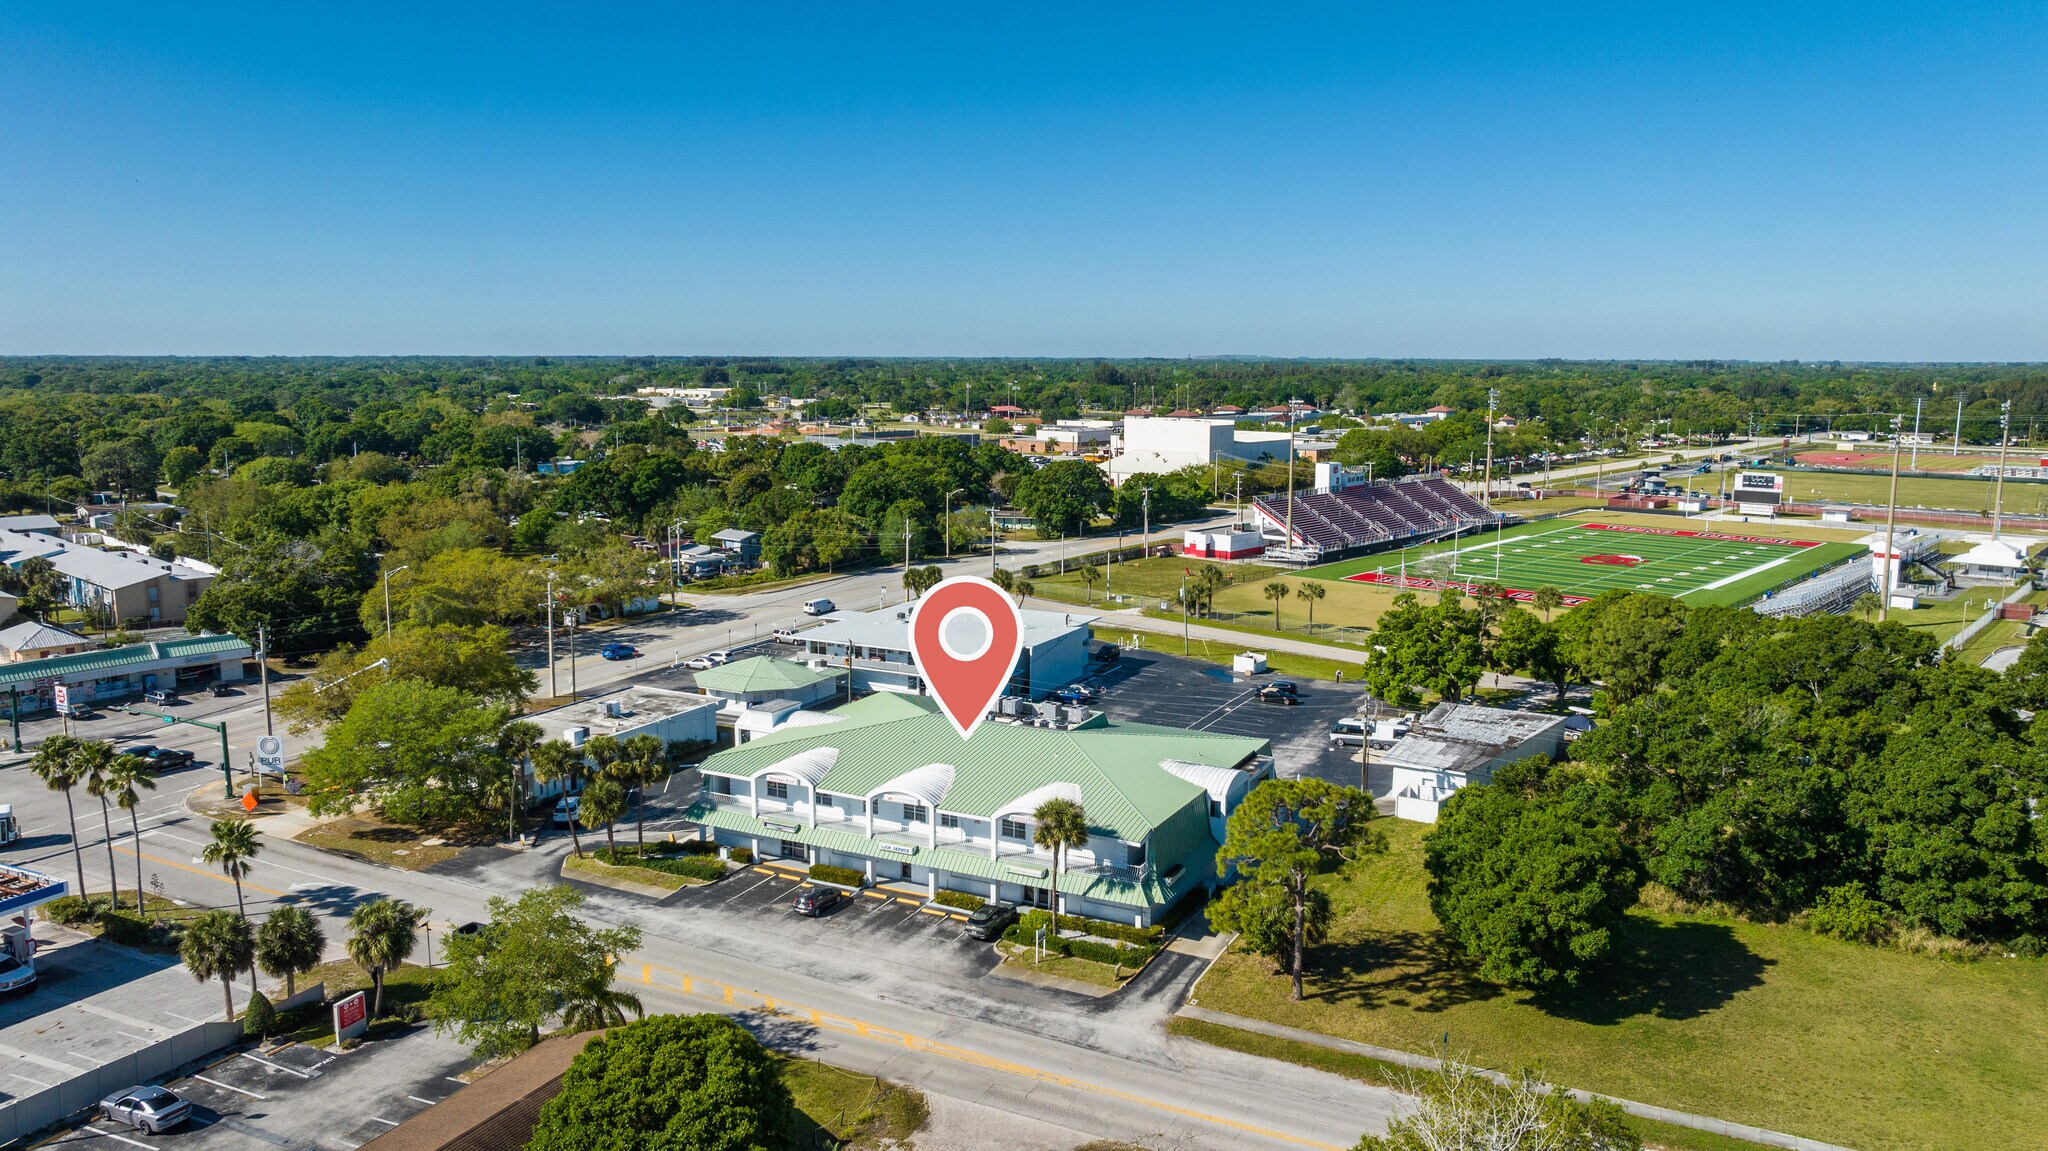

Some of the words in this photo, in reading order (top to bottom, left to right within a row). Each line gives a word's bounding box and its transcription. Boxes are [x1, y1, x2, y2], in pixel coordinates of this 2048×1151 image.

[261, 756, 281, 764] PUR
[892, 846, 910, 854] SERVICE
[302, 1055, 337, 1074] COMPACT
